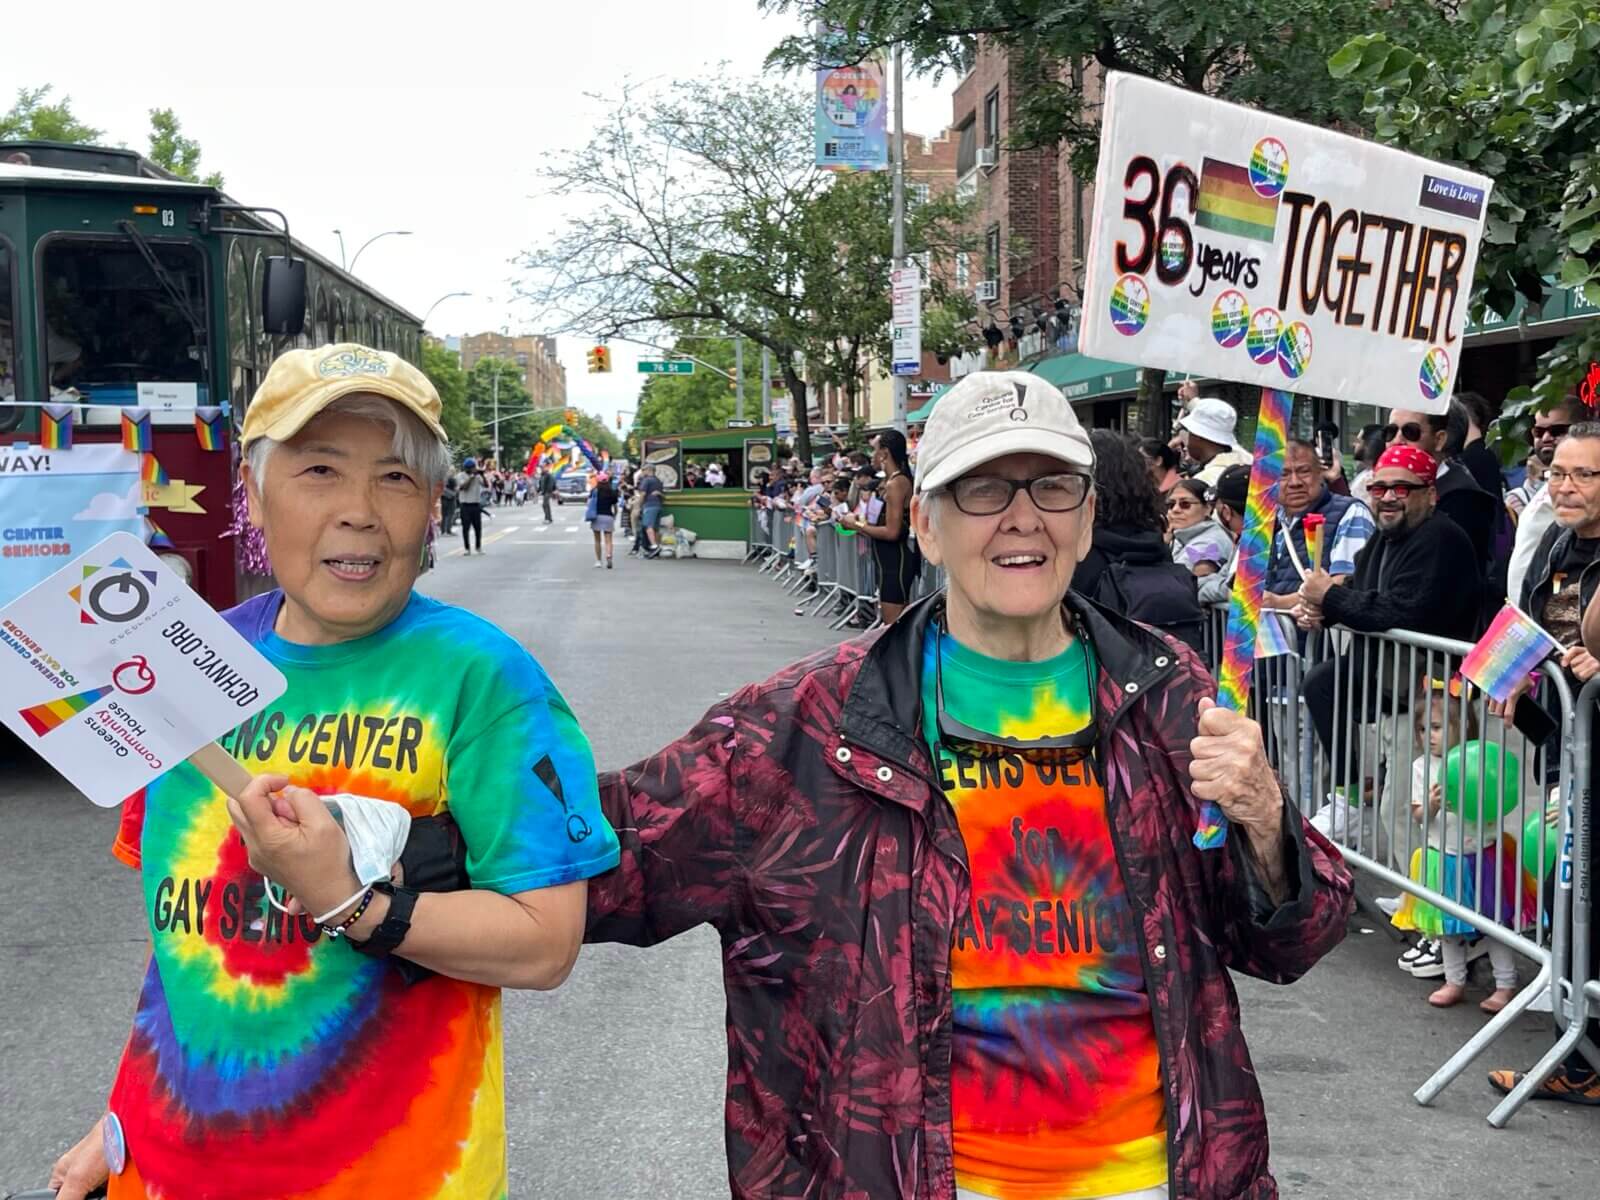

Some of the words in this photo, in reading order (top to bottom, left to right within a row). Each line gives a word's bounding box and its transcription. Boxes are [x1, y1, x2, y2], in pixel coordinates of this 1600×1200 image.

[1428, 178, 1449, 195] Love
[1449, 184, 1458, 198] is
[1457, 186, 1478, 203] Love
[162, 209, 175, 226] 03
[1115, 156, 1200, 287] 36
[1189, 242, 1261, 297] years
[1278, 191, 1467, 344] TOGETHER
[2, 543, 71, 558] SENIORS
[3, 528, 64, 541] CENTER
[0, 628, 32, 659] CENTER
[2, 620, 43, 654] SENIORS
[30, 658, 66, 689] QUEENS
[40, 654, 61, 671] GAY
[59, 668, 80, 687] FOR
[162, 620, 259, 708] QCHNYC.ORG
[108, 701, 146, 737] House
[83, 716, 129, 757] Queens
[96, 710, 162, 769] Community
[288, 712, 424, 774] CENTER
[154, 876, 212, 936] GAY
[220, 879, 323, 944] SENIO
[951, 899, 998, 952] AY
[1009, 899, 1119, 955] SENIO
